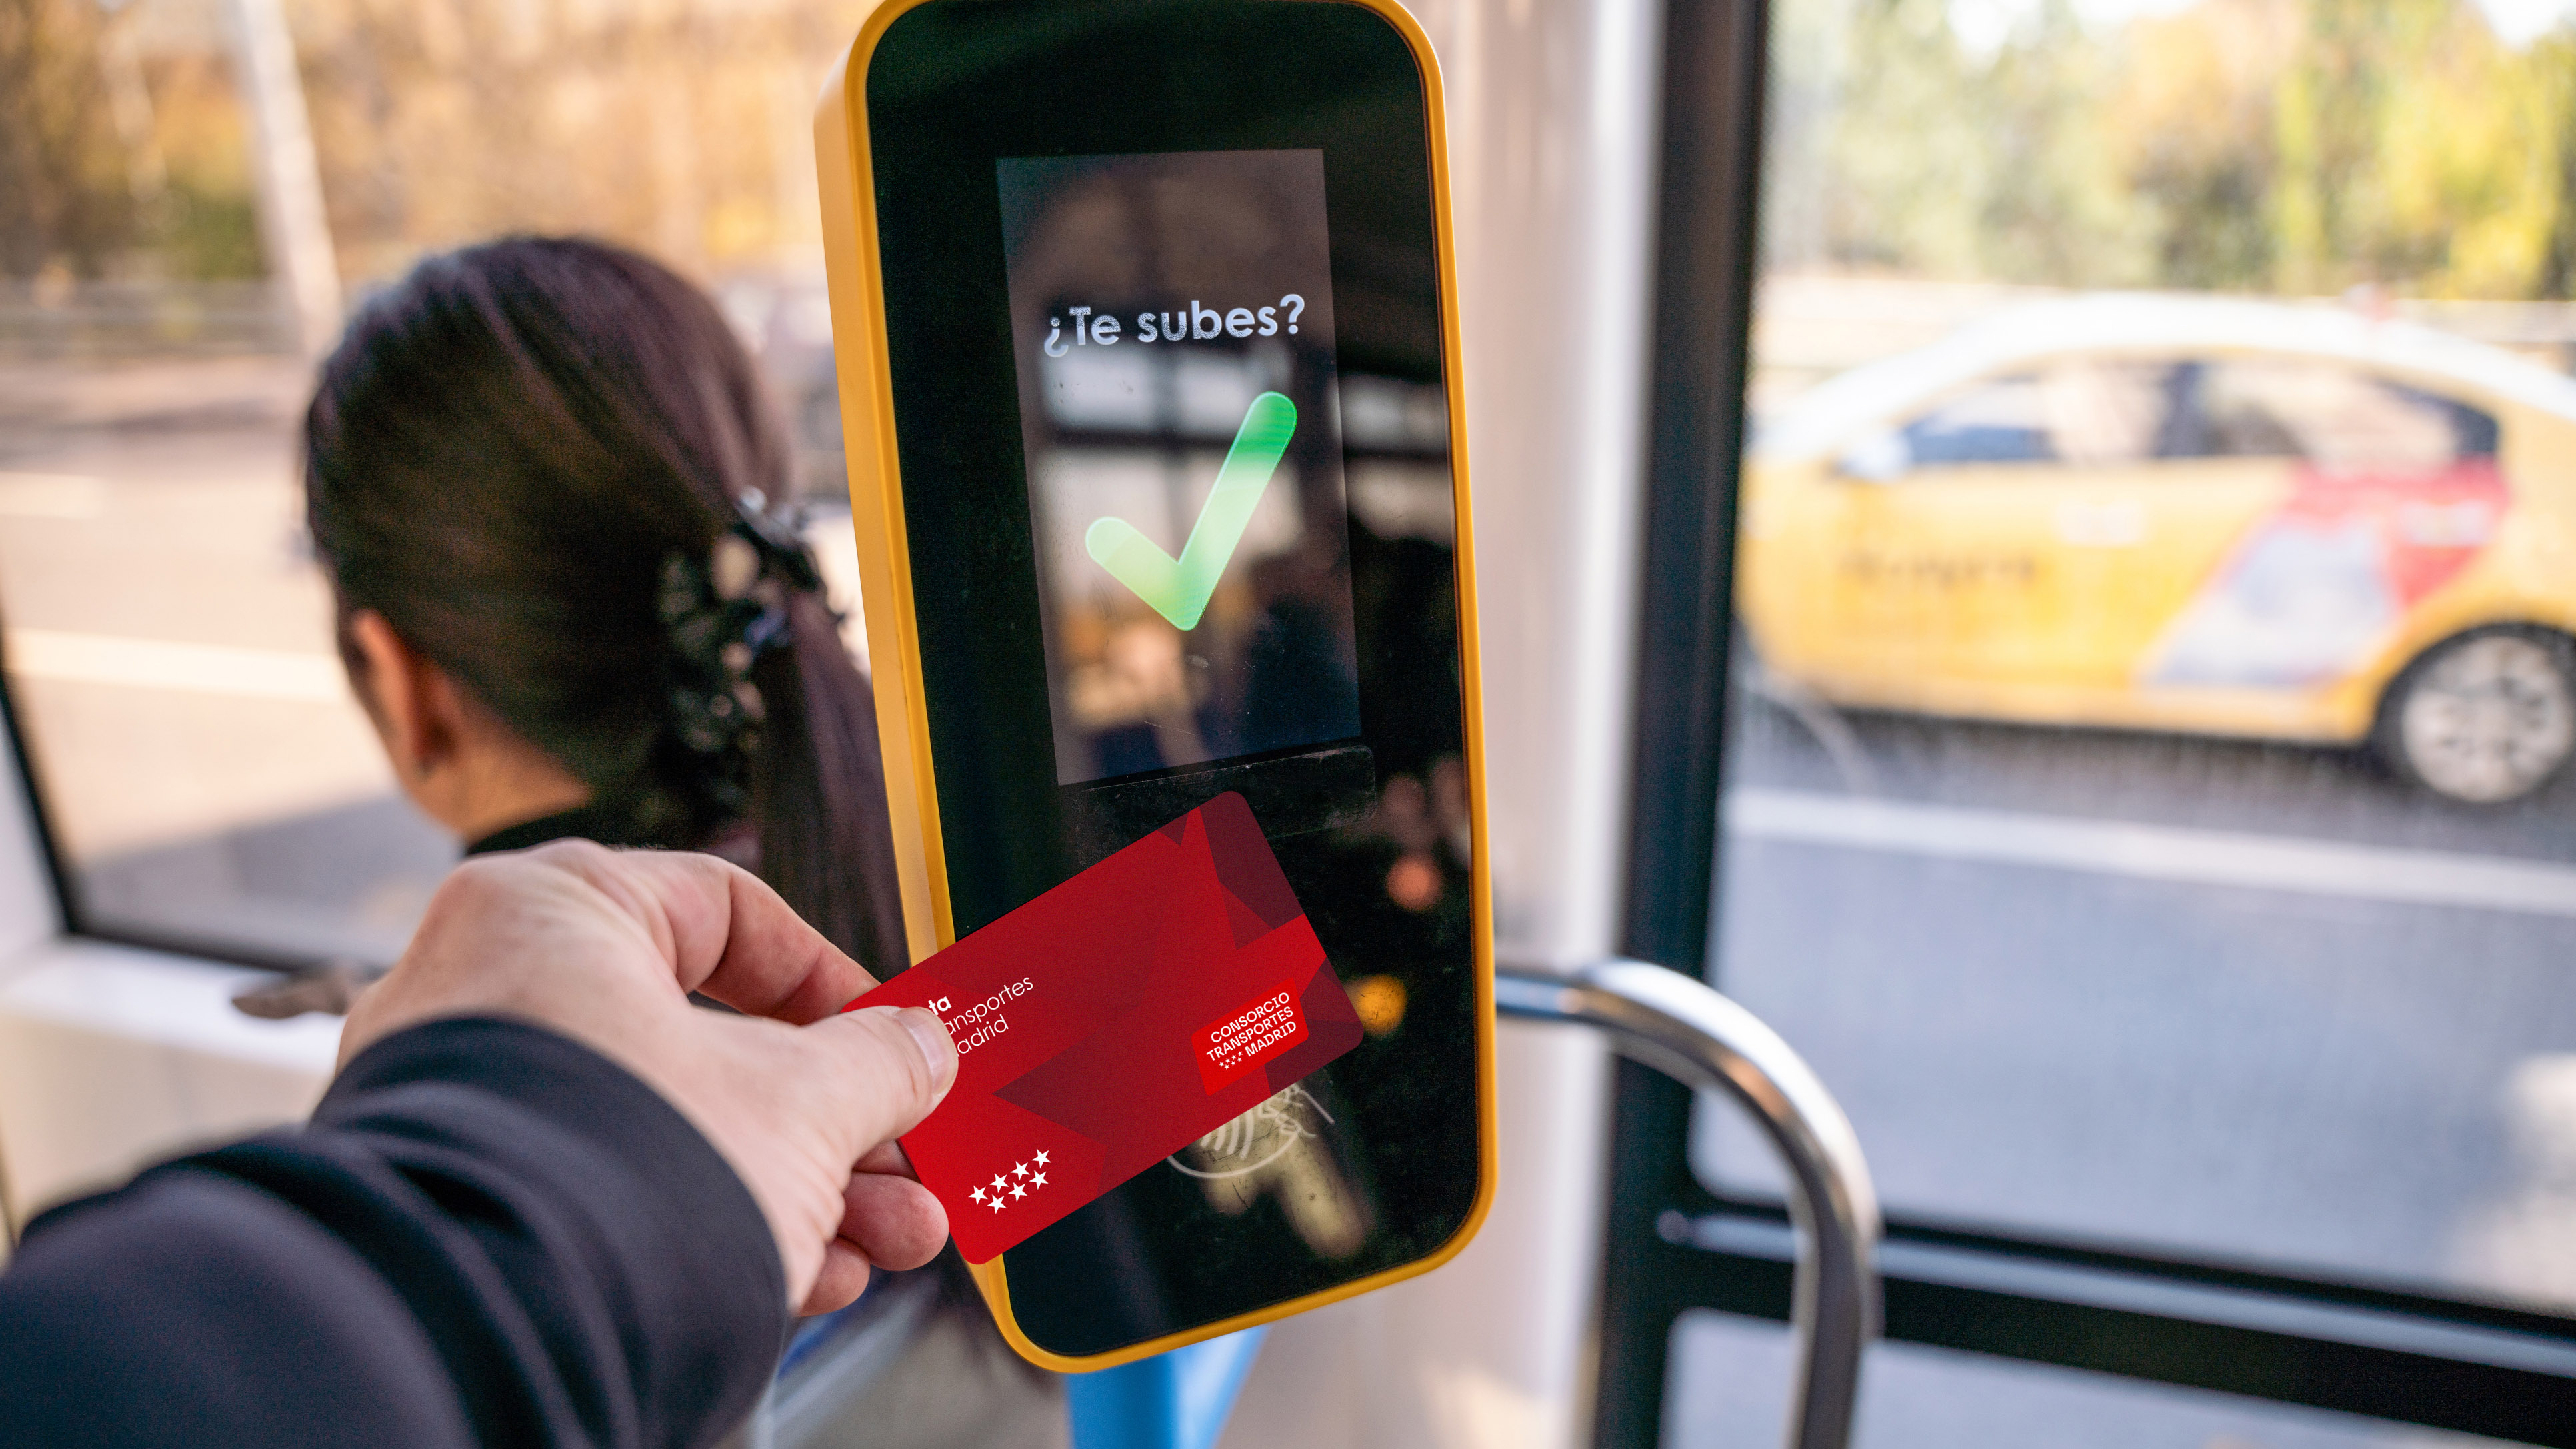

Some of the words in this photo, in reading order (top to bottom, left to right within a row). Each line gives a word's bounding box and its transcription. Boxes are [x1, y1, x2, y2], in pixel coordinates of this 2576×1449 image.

[1043, 306, 1121, 357] ¿Te
[1137, 293, 1305, 343] subes?
[928, 996, 952, 1016] ta
[944, 977, 1033, 1035] ansportes
[1211, 992, 1289, 1043] CONSORCIO
[957, 1014, 1009, 1057] adrid
[1206, 1006, 1293, 1061] TRANSPORTES
[1245, 1021, 1297, 1057] MADRID
